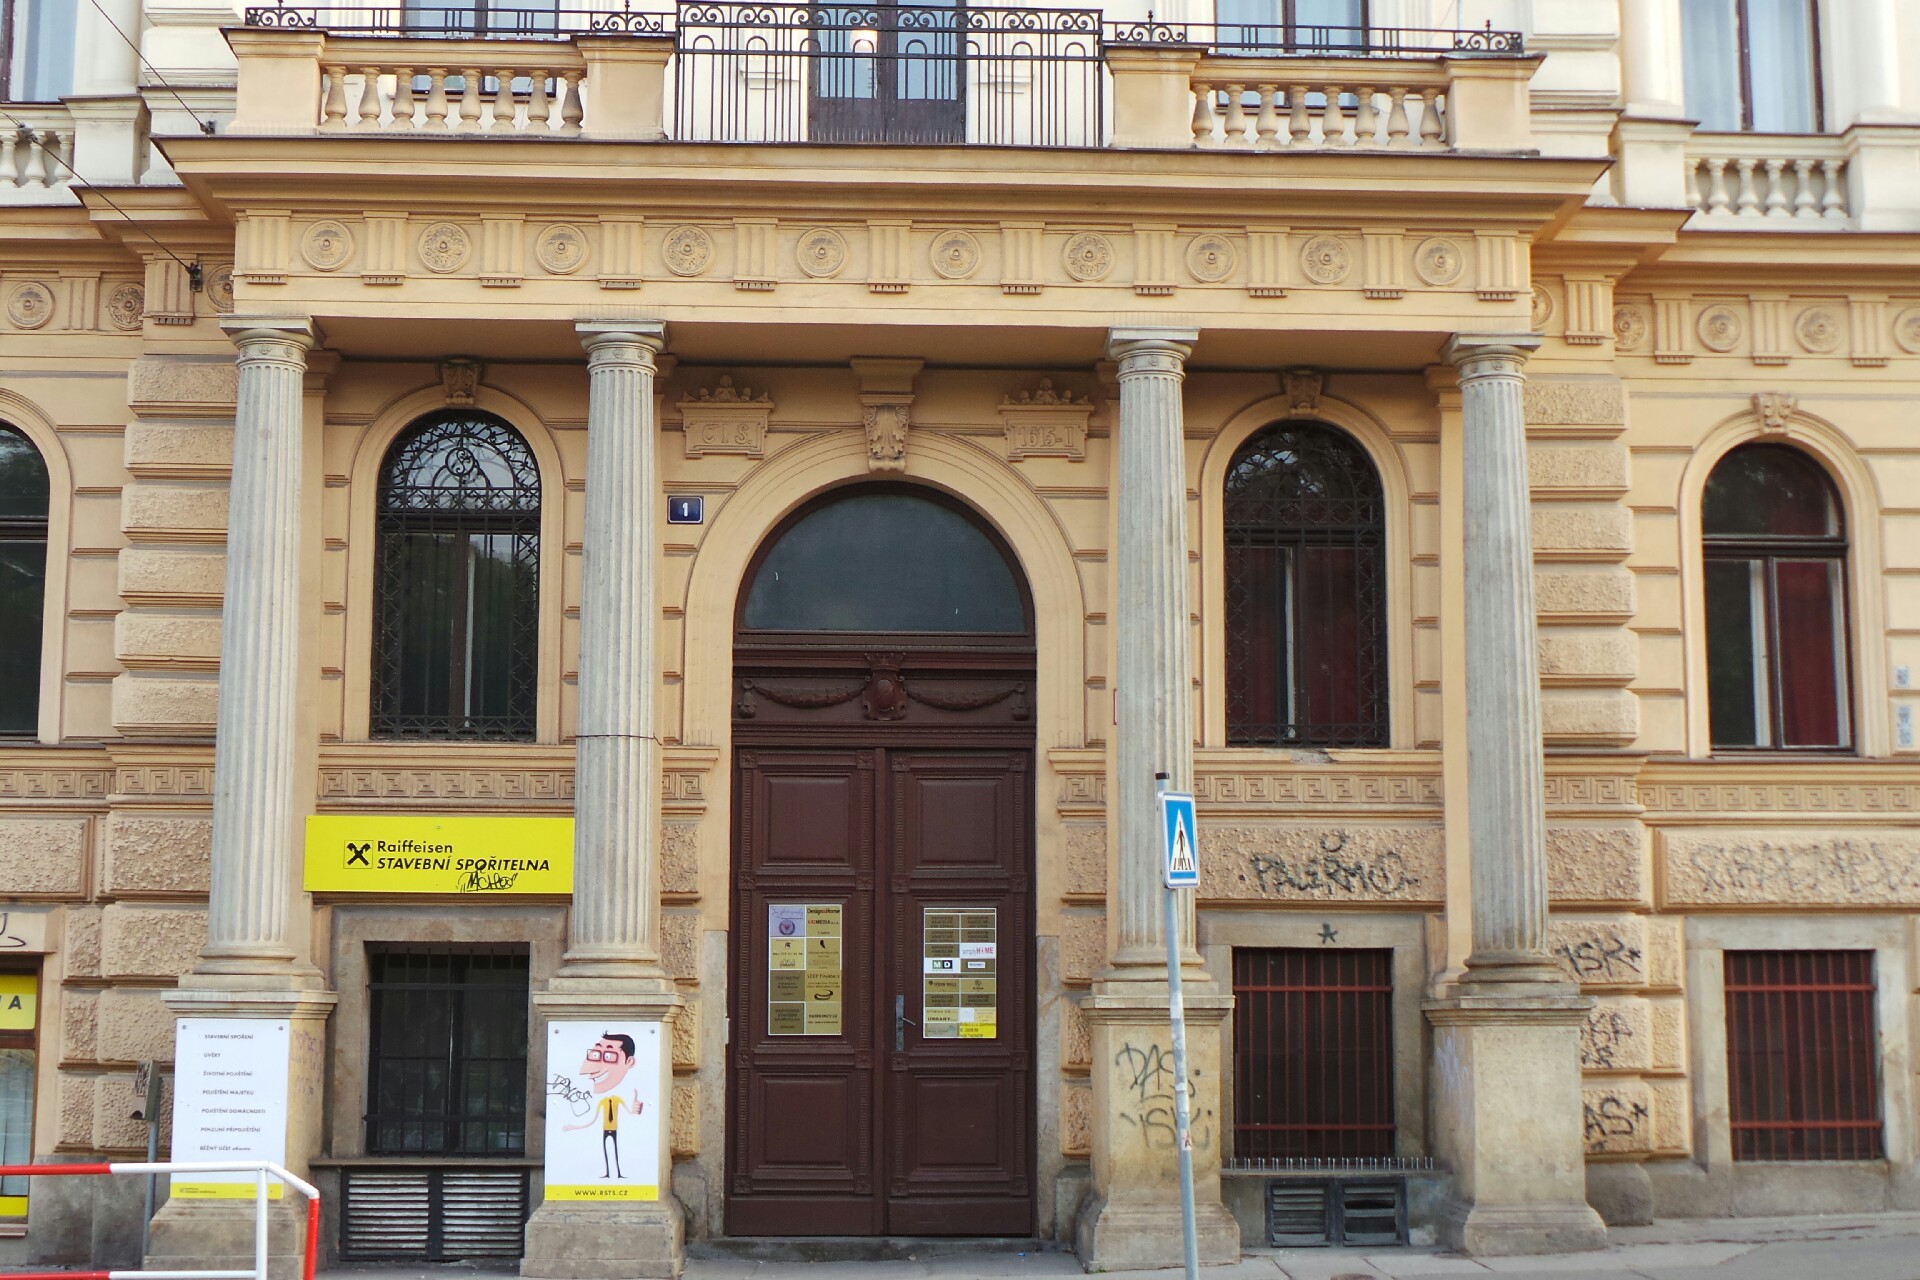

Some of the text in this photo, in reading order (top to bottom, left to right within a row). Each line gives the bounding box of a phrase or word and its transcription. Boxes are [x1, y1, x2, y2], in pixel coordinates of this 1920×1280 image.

[682, 502, 689, 517] 1
[377, 840, 453, 854] Raiffeisen
[377, 856, 550, 871] STAVEBNÍ SPOŘITELNA
